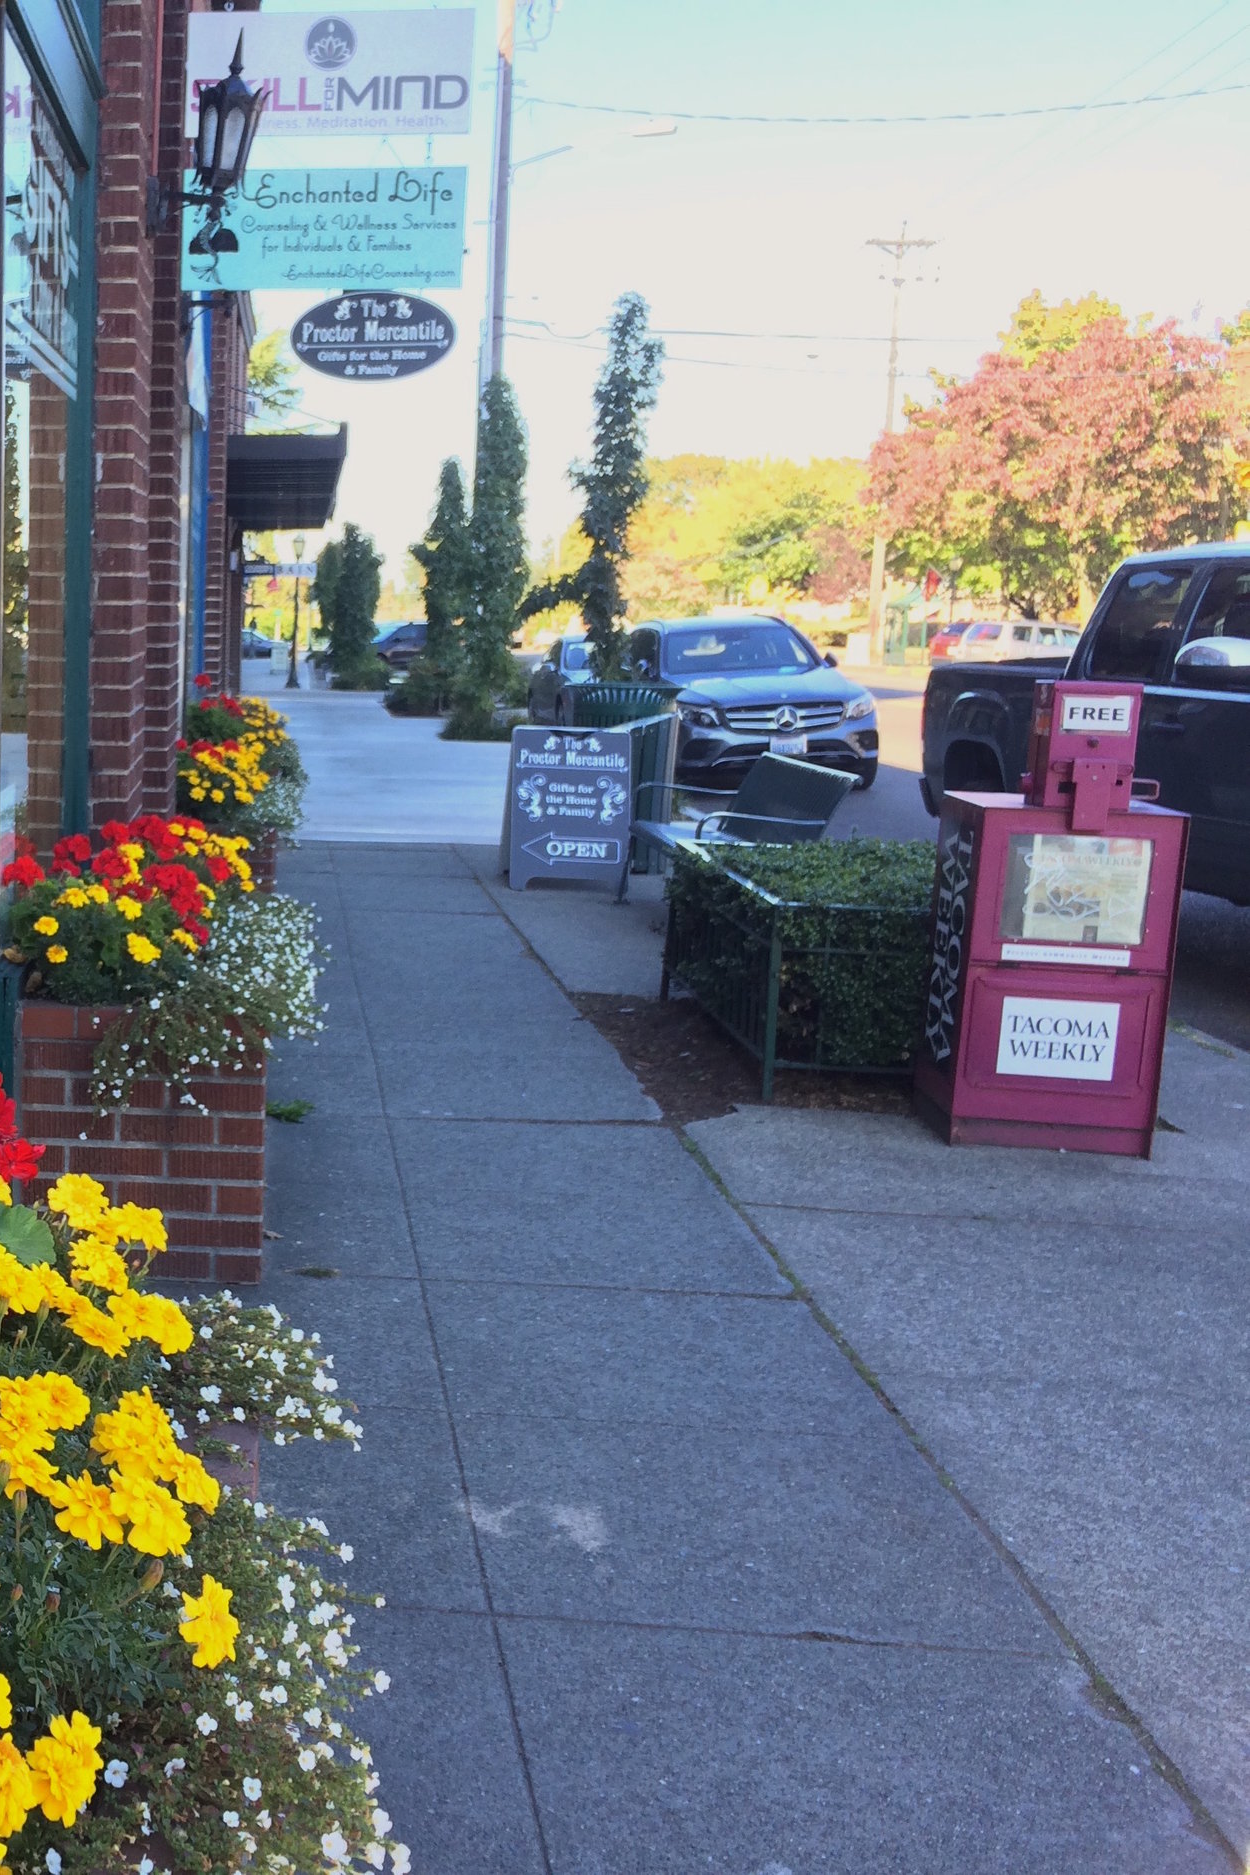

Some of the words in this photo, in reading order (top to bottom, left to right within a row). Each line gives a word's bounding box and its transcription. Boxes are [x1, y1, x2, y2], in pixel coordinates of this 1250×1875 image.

[242, 172, 379, 209] Enchanted
[388, 170, 454, 216] Life
[241, 215, 309, 238] Counseling
[313, 214, 328, 232] &
[331, 213, 398, 232] Wellness
[402, 212, 458, 231] Services
[261, 236, 279, 259] for
[283, 235, 344, 253] Individuals
[347, 235, 361, 252] &
[366, 234, 413, 252] Families
[360, 298, 388, 319] The
[301, 321, 359, 344] Proctor
[364, 319, 446, 342] Mercantile
[317, 350, 347, 362] Gifts
[349, 350, 367, 361] for
[370, 350, 390, 361] the
[391, 350, 428, 361] Home
[344, 364, 357, 376] &
[358, 364, 401, 377] Family
[1068, 706, 1126, 721] FREE
[563, 737, 583, 750] The
[520, 748, 562, 766] Proctor
[565, 751, 626, 769] Mercantile
[548, 783, 576, 794] Gifts
[577, 784, 595, 794] for
[545, 795, 564, 805] the
[565, 796, 597, 806] Home
[559, 807, 597, 819] Family
[546, 841, 609, 859] OPEN
[1007, 1012, 1110, 1040] TACOMA
[1009, 1038, 1107, 1064] WEEKLY
